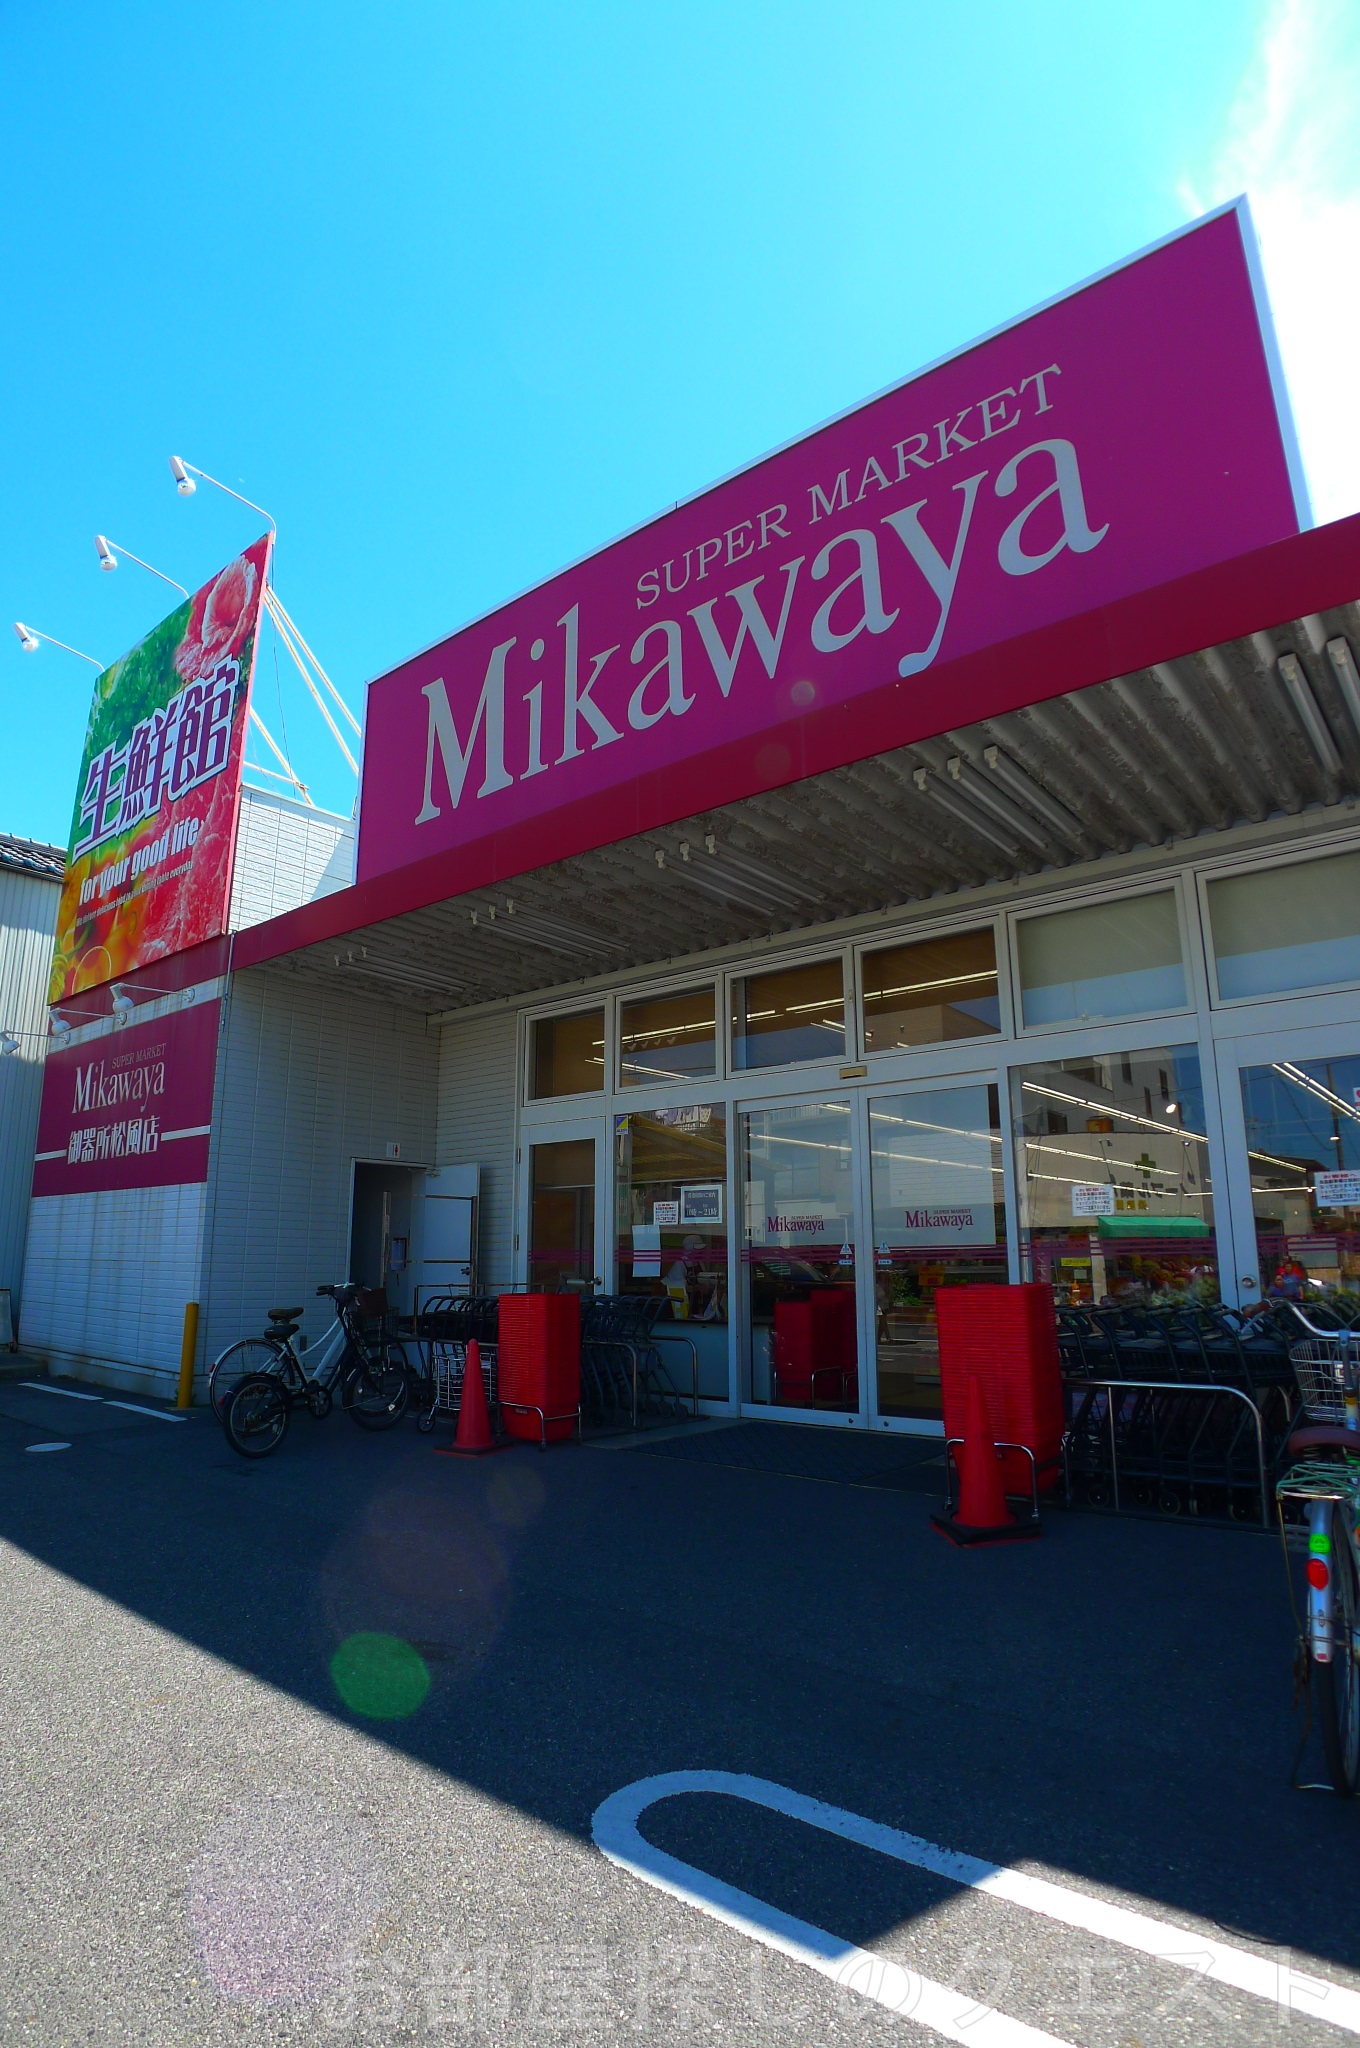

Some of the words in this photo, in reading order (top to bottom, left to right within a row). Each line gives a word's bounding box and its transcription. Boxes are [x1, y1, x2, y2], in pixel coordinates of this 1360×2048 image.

[636, 503, 791, 610] SUPER
[807, 364, 1062, 524] MARKET
[414, 438, 1109, 825] Mikawaya
[72, 653, 240, 865] 生鮮館
[79, 875, 99, 906] for
[100, 856, 130, 898] your
[131, 830, 170, 881] good
[171, 816, 199, 856] life
[112, 1052, 134, 1069] SUPER
[136, 1043, 166, 1062] MARKET
[72, 1060, 164, 1113] Mikawaya
[67, 1115, 160, 1164] 御器所松風店
[767, 1216, 825, 1235] Mikawaya
[905, 1210, 973, 1230] Mikawaya
